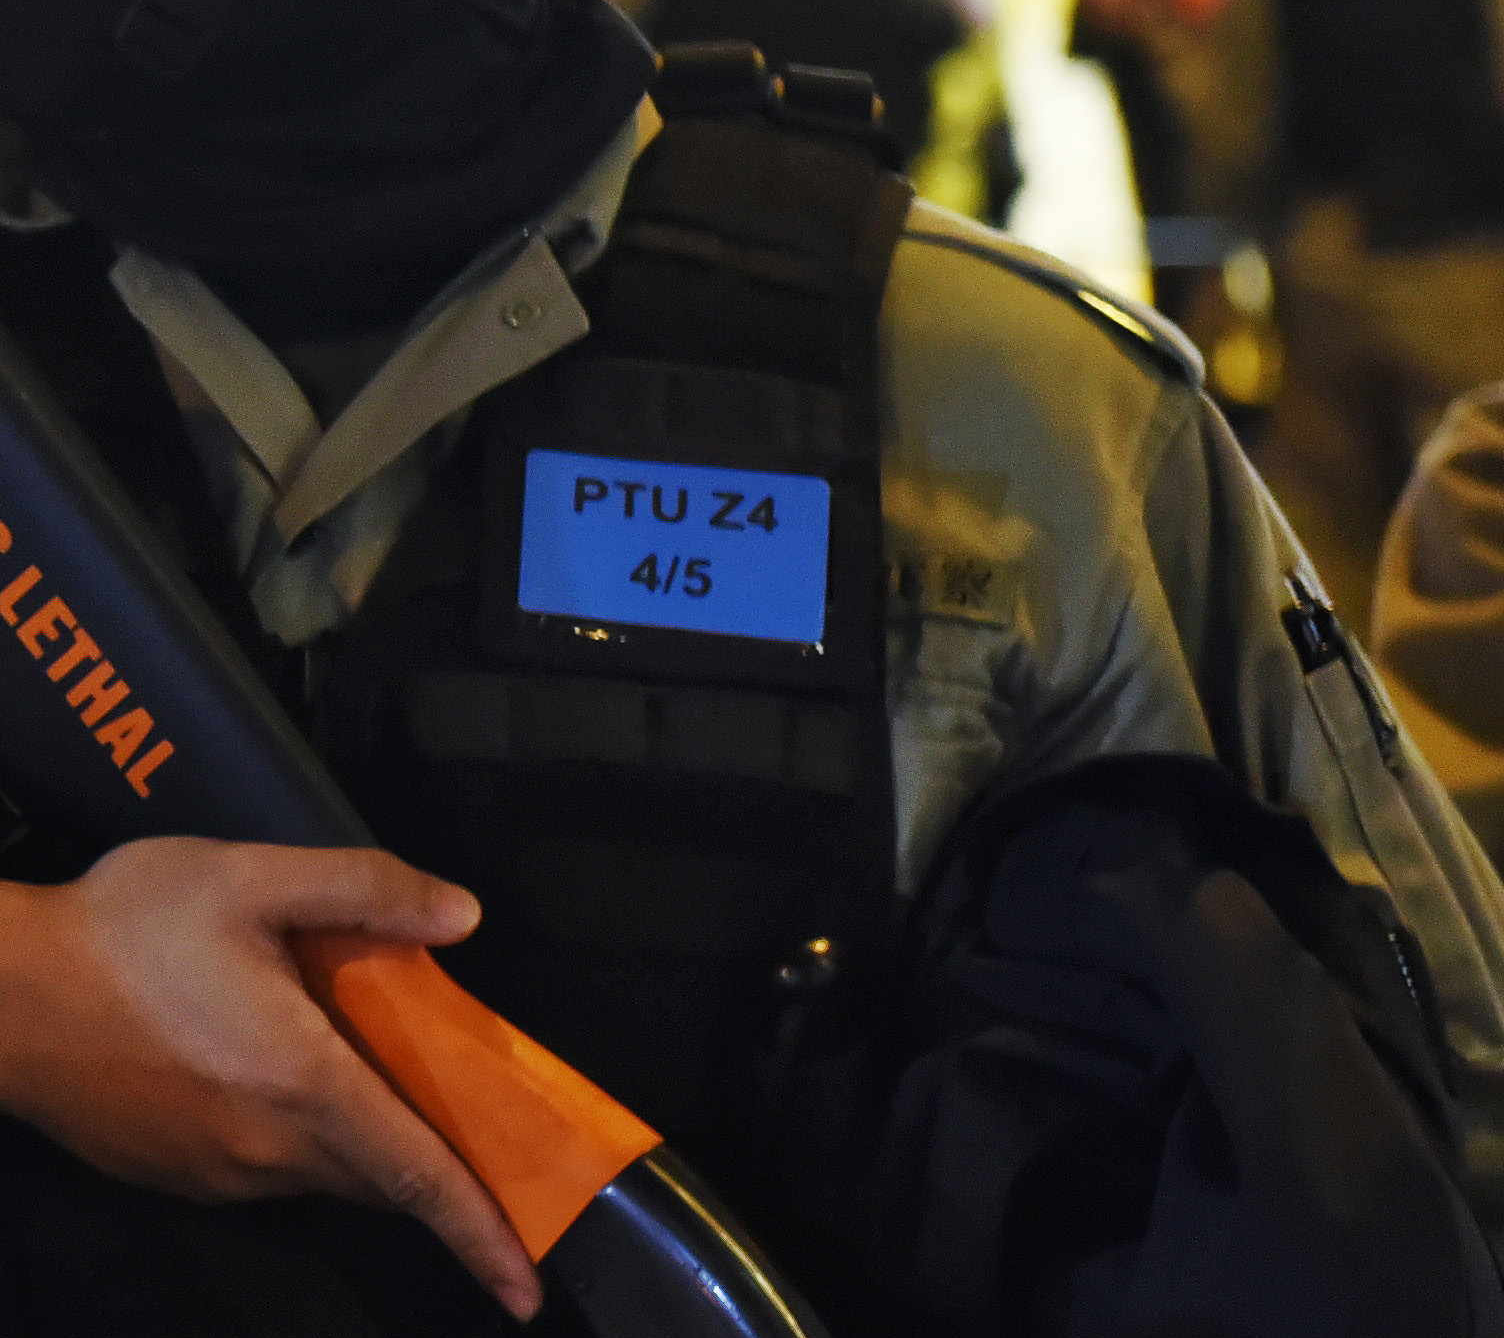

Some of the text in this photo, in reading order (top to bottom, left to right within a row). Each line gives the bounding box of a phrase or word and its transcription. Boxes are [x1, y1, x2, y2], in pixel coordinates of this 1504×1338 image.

[573, 476, 778, 533] PTU Z4
[630, 552, 712, 598] 4/5
